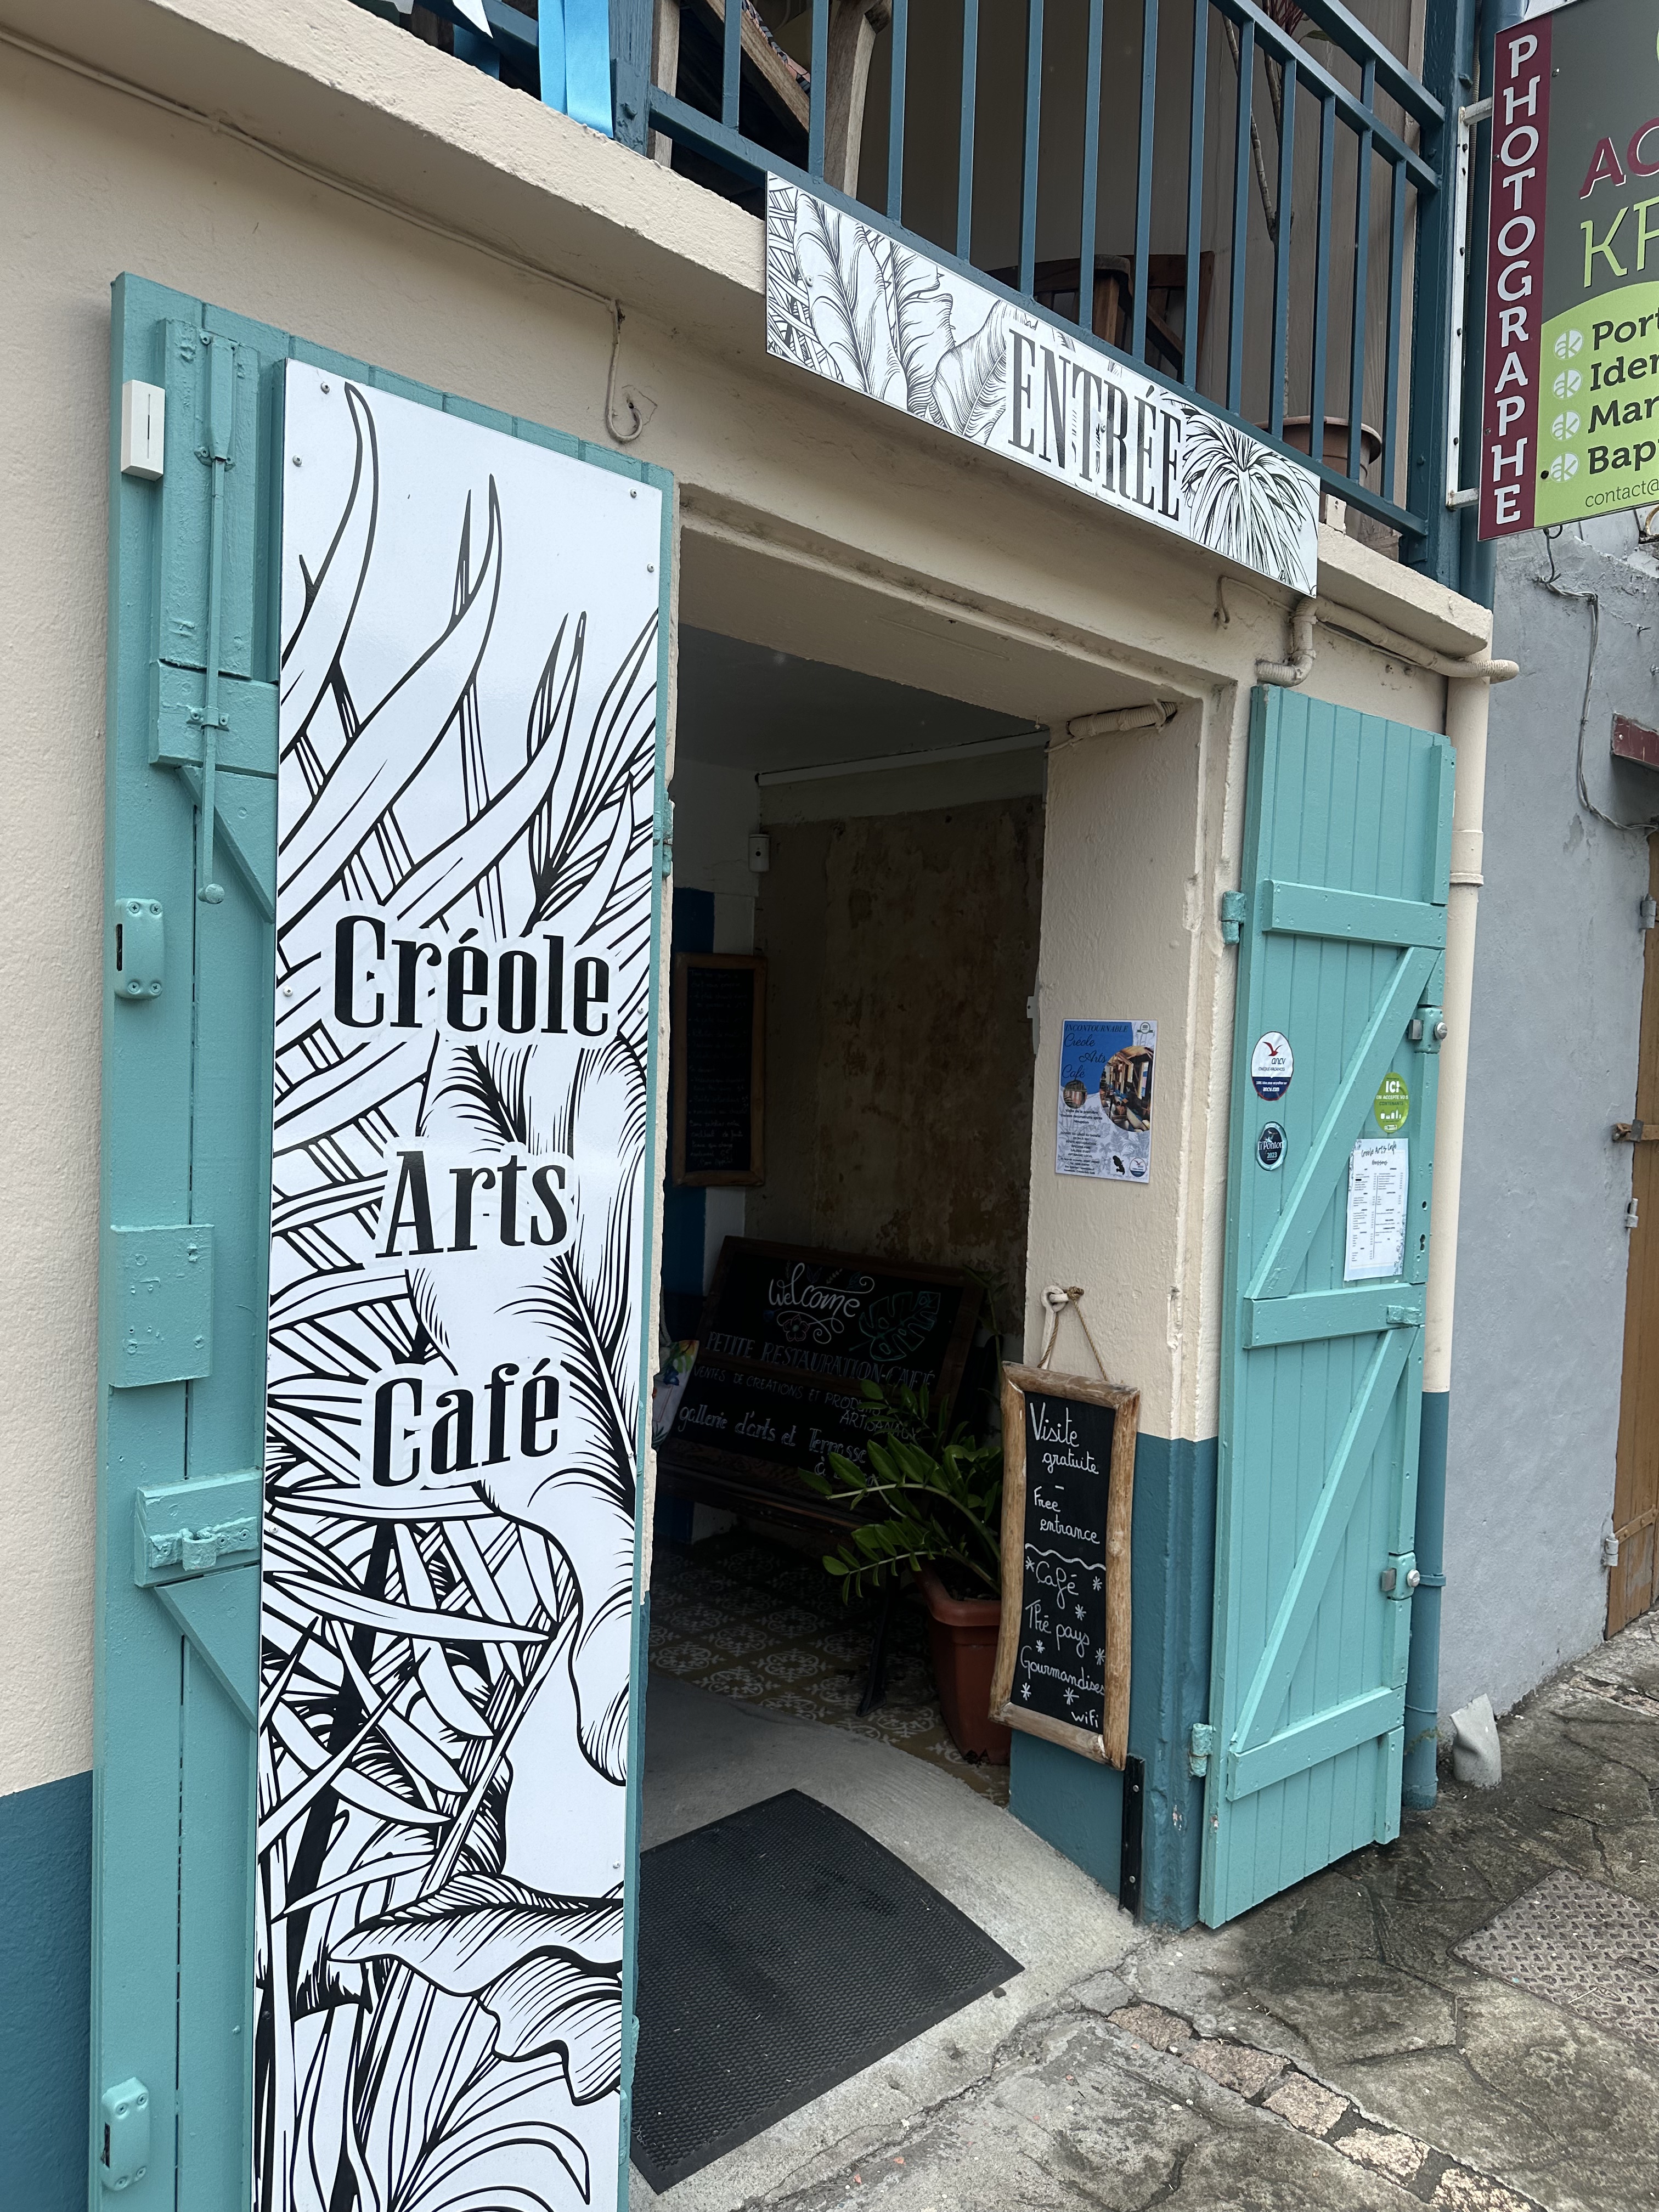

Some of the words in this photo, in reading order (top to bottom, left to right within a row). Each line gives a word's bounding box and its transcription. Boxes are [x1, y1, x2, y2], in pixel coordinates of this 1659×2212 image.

[1492, 34, 1541, 525] PHOTOGRAPHE
[1008, 328, 1182, 522] ENTRÉE
[1588, 439, 1659, 475] Bap
[334, 915, 610, 1036] Créole
[1064, 1032, 1096, 1047] Créole
[1065, 1024, 1128, 1032] INCONTOURNABLE
[1062, 1064, 1085, 1080] Café
[1079, 1050, 1107, 1063] Arts
[375, 1148, 568, 1259] Arts
[705, 1331, 755, 1358] PETITE
[694, 1364, 727, 1382] VENTES
[732, 1373, 745, 1385] DE
[809, 1389, 821, 1402] ET
[373, 1359, 560, 1487] Café
[781, 1425, 797, 1447] et
[1030, 1402, 1080, 1447] Visite
[1042, 1448, 1099, 1474] gratuite
[1034, 1486, 1061, 1513] Free
[1040, 1514, 1101, 1544] entrance
[1035, 1560, 1079, 1610] Café
[1025, 1599, 1052, 1634] Thé
[1056, 1623, 1090, 1658] pays
[1020, 1645, 1105, 1696] Gourmandises
